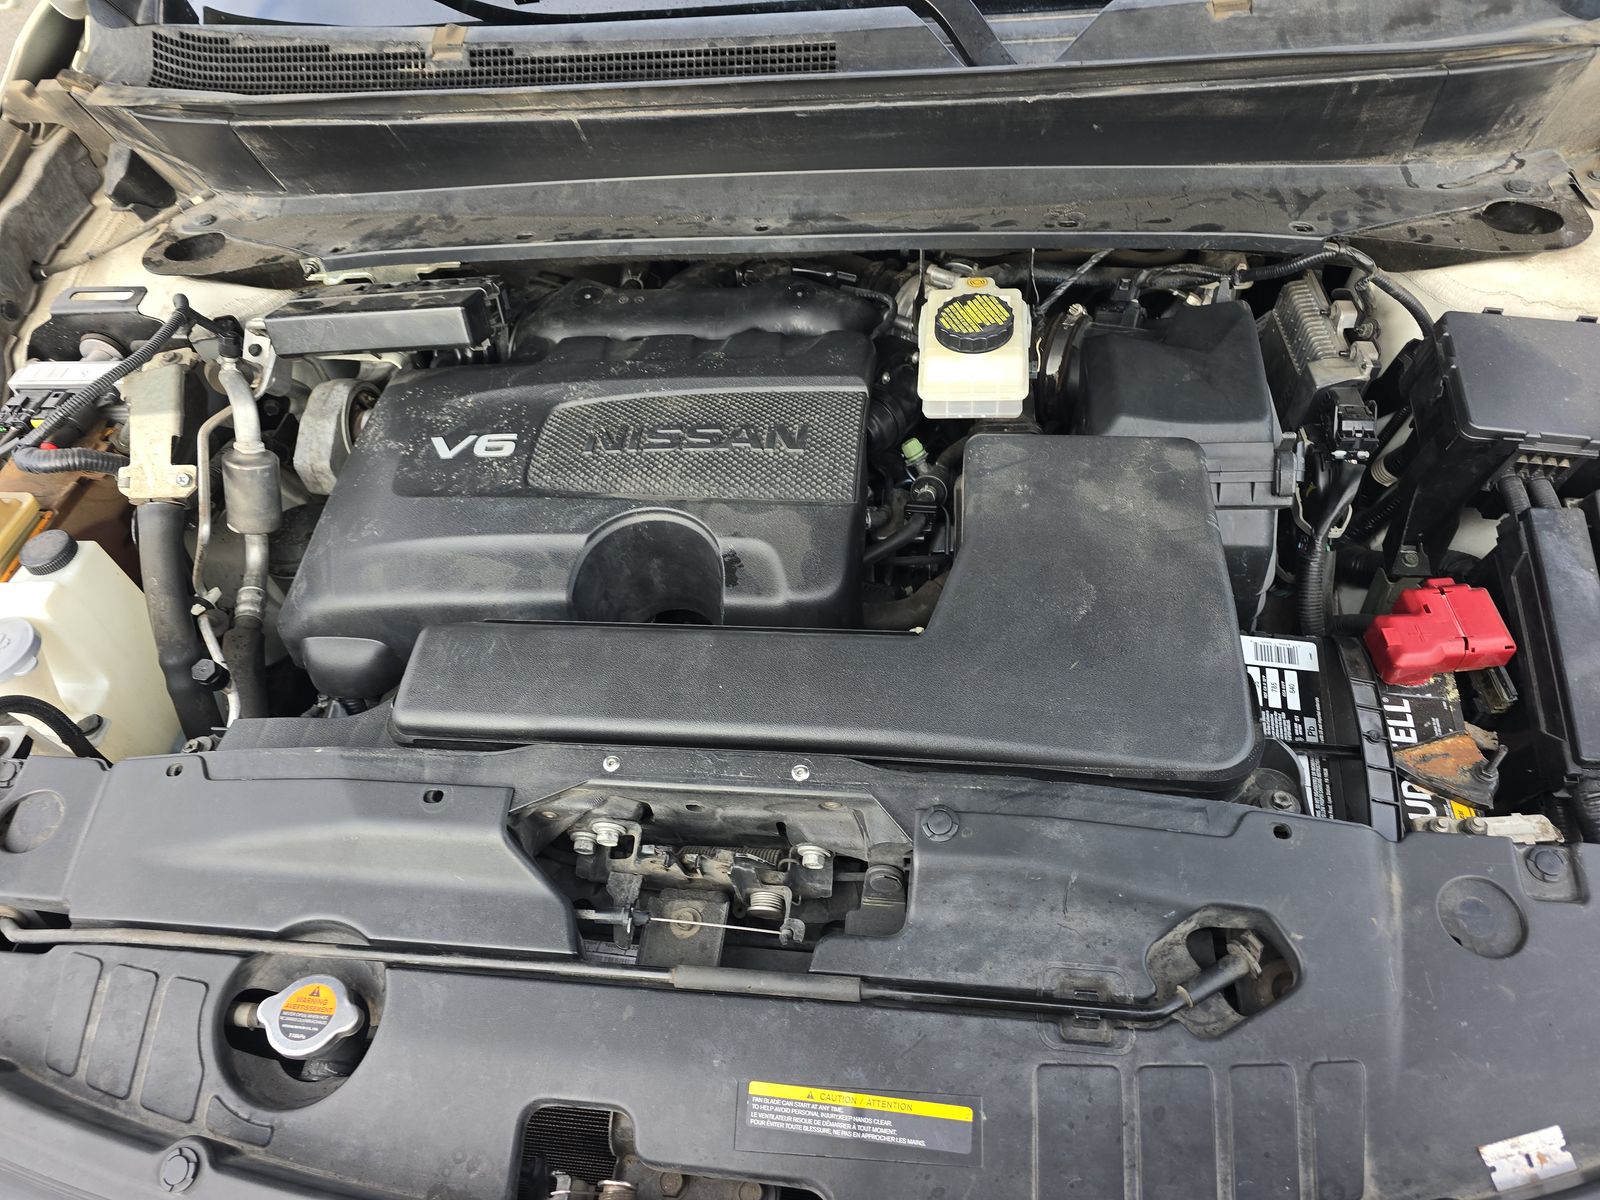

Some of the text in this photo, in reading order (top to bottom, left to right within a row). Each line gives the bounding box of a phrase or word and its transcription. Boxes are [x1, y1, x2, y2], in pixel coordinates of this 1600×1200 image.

[431, 423, 809, 460] V6 NISSAN
[1307, 725, 1317, 738] Pb
[763, 1097, 781, 1105] BLADE
[782, 1099, 793, 1107] CAN
[794, 1101, 811, 1109] START
[819, 1092, 857, 1105] CAUTION
[866, 1099, 913, 1112] ATTENTION
[758, 1112, 793, 1122] VENTILATEUR
[793, 1116, 813, 1125] RISQUE
[821, 1120, 852, 1131] DÉMARRER
[857, 1124, 872, 1132] TOUT
[760, 1104, 774, 1112] HELP
[774, 1106, 791, 1114] AVOID
[791, 1108, 820, 1118] PERSONAL
[853, 1115, 872, 1124] HANDS
[750, 1118, 766, 1126] POUR
[766, 1119, 785, 1129] ÉVITER
[785, 1122, 803, 1130] TOUTE
[832, 1128, 841, 1136] NE
[841, 1130, 853, 1138] PAS
[853, 1131, 861, 1139] EN
[861, 1132, 896, 1143] APPROCHER
[895, 1136, 907, 1144] LES
[906, 1138, 927, 1148] MAINS.
